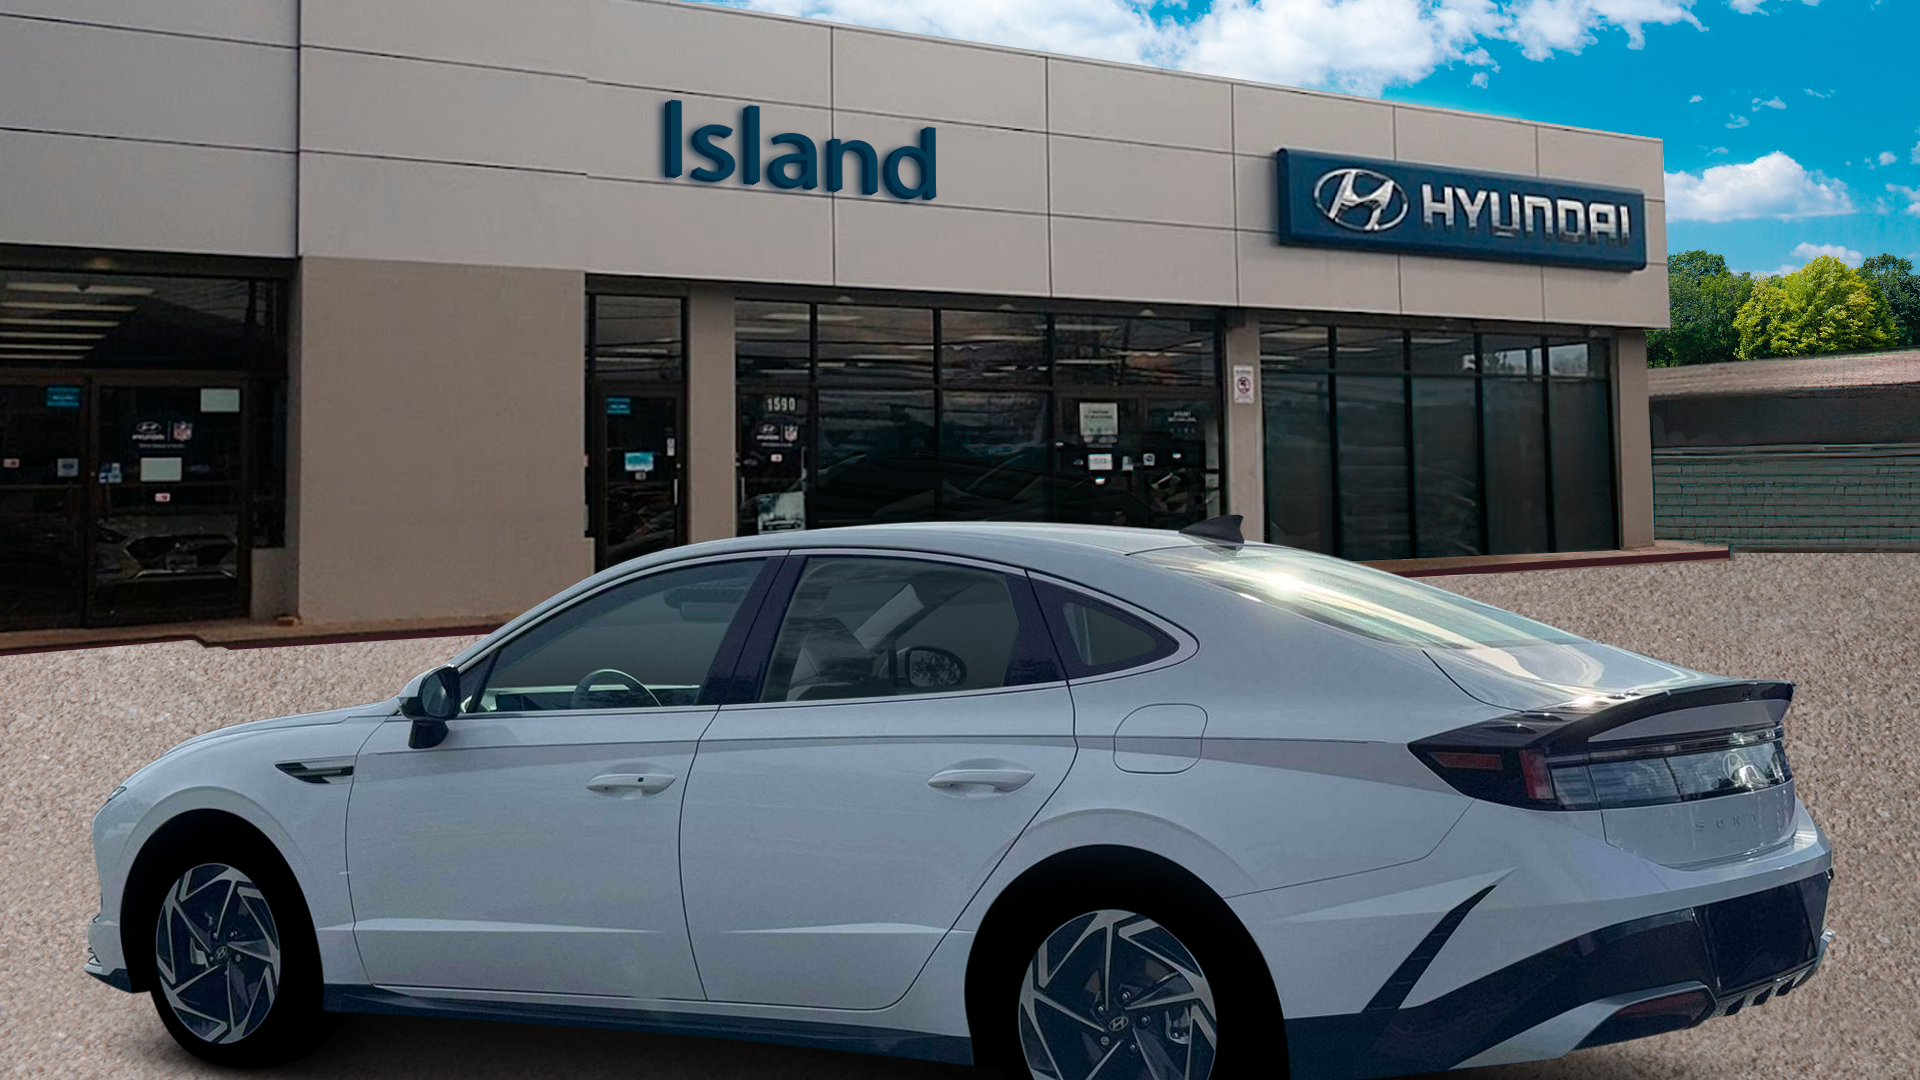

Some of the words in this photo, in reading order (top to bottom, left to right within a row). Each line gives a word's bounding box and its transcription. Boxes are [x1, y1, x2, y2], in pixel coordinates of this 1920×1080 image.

[664, 99, 937, 201] Island
[1421, 184, 1632, 245] HYUNDAI
[766, 396, 796, 412] 1590
